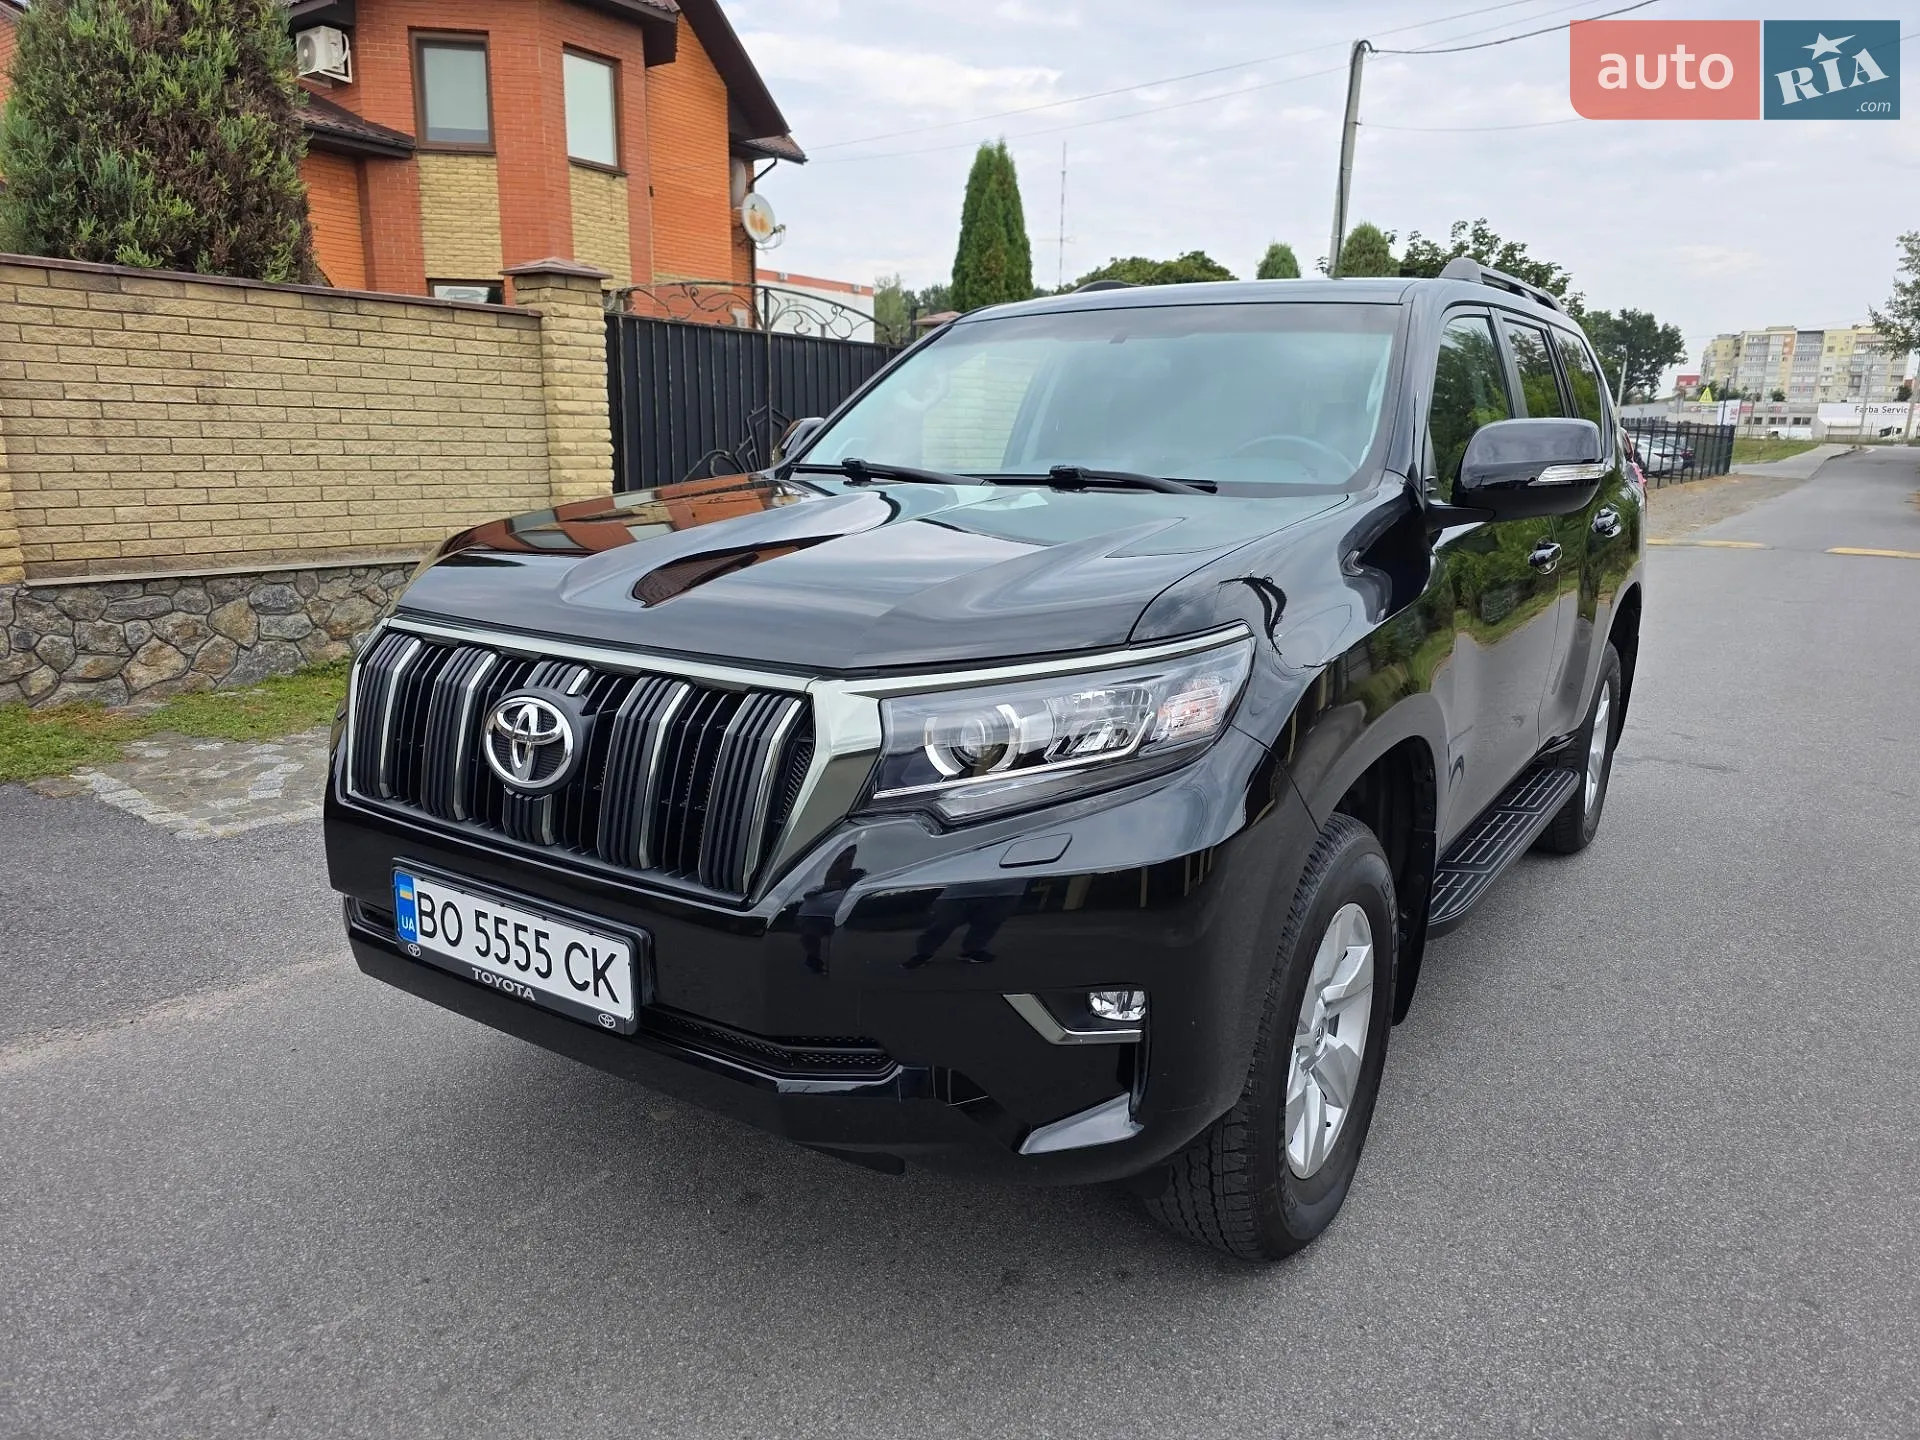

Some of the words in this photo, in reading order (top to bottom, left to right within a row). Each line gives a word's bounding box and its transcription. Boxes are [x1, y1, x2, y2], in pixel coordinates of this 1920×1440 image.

[1881, 405, 1912, 414] Servic
[401, 914, 415, 932] UA
[416, 890, 463, 947] BO
[474, 909, 552, 979] 5555
[564, 941, 620, 1004] CK
[472, 967, 536, 1001] TOYOTA
